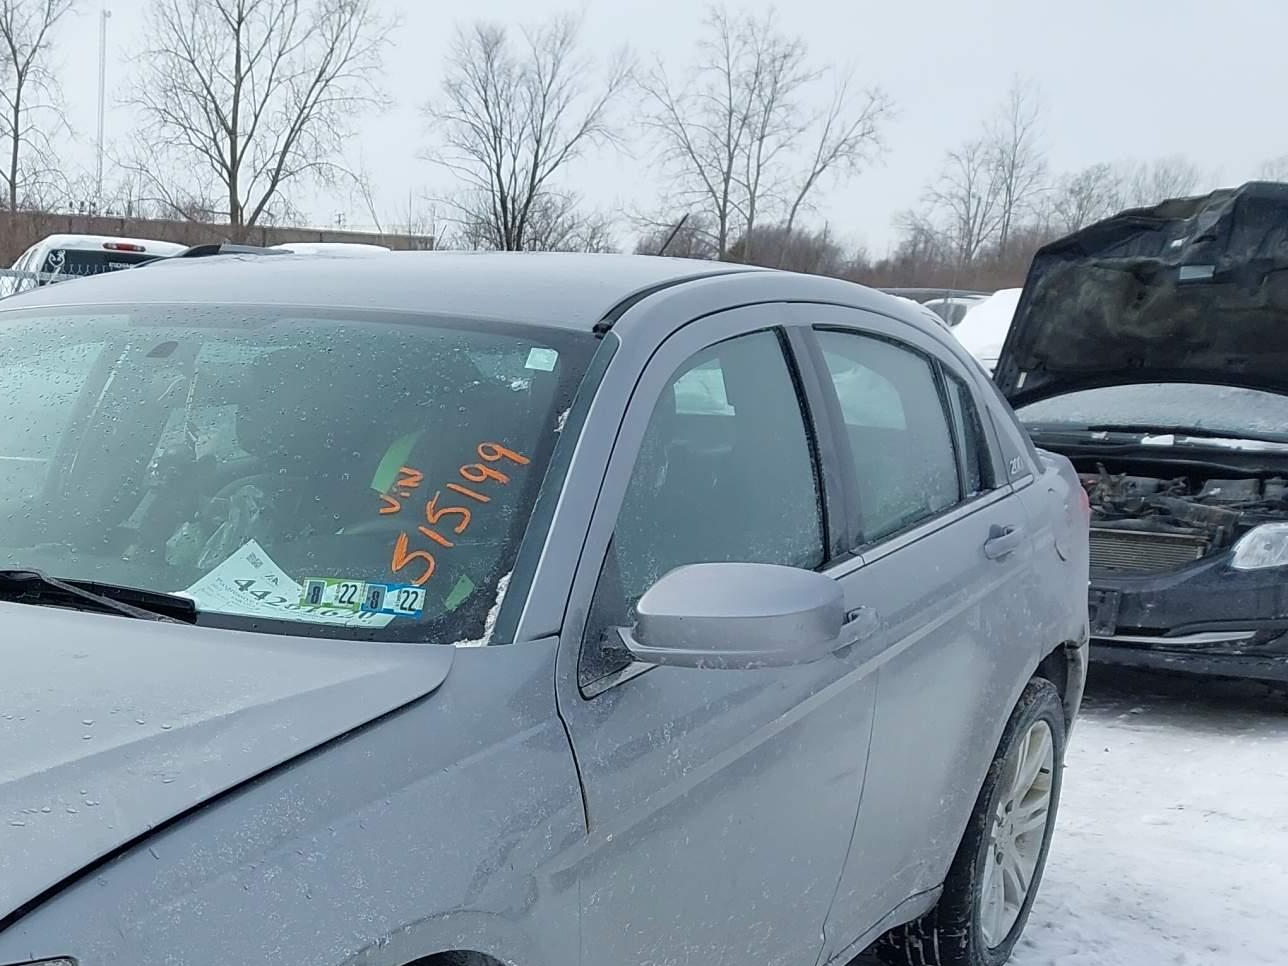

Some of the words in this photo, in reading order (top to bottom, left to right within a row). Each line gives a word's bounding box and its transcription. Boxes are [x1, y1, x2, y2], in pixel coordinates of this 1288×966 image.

[392, 442, 531, 586] 515199
[311, 586, 322, 604] 8
[338, 584, 358, 604] 22
[370, 591, 381, 609] 8
[399, 590, 419, 611] 22
